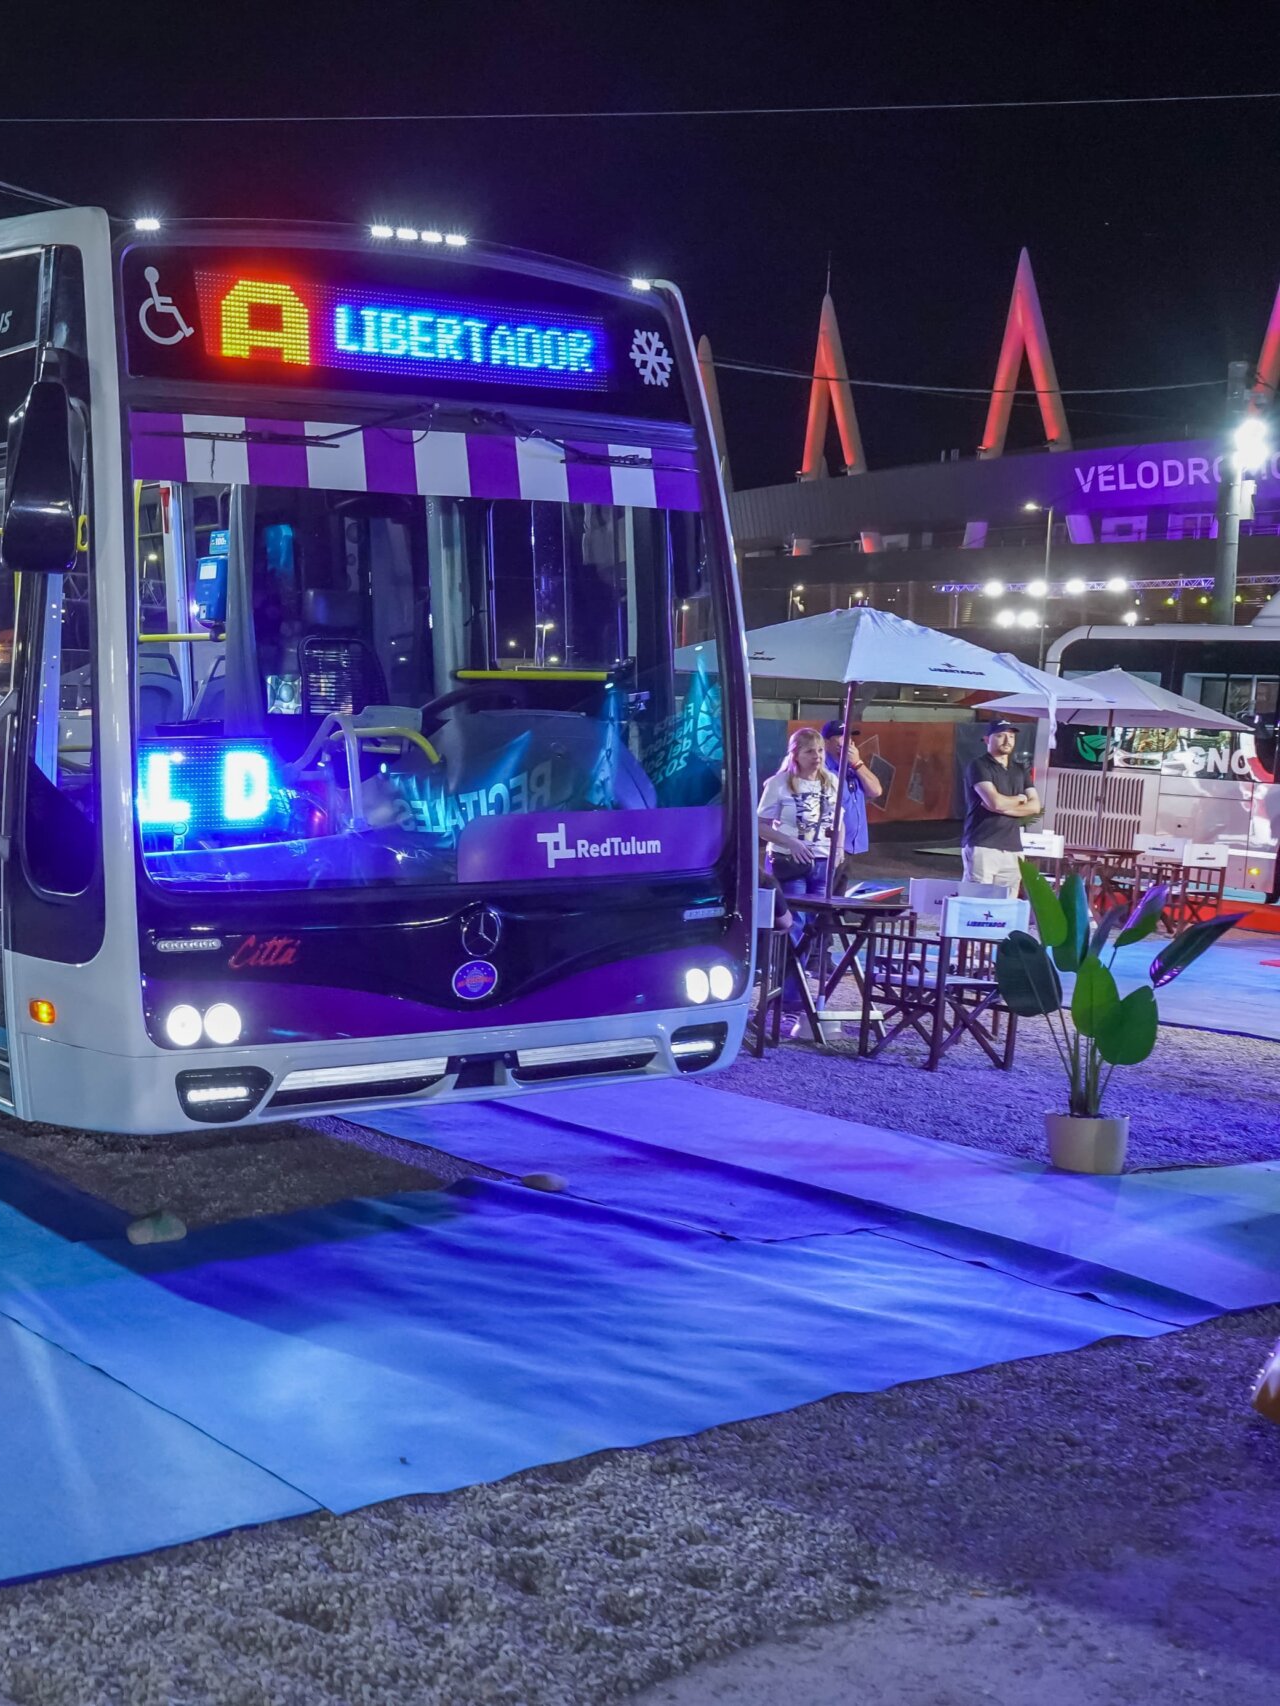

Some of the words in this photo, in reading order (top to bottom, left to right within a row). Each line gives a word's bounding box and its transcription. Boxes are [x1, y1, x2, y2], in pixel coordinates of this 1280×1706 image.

[221, 280, 310, 366] A
[335, 305, 594, 373] LIBERTADOR
[1074, 452, 1280, 493] VELODR
[576, 836, 662, 859] RedTulum
